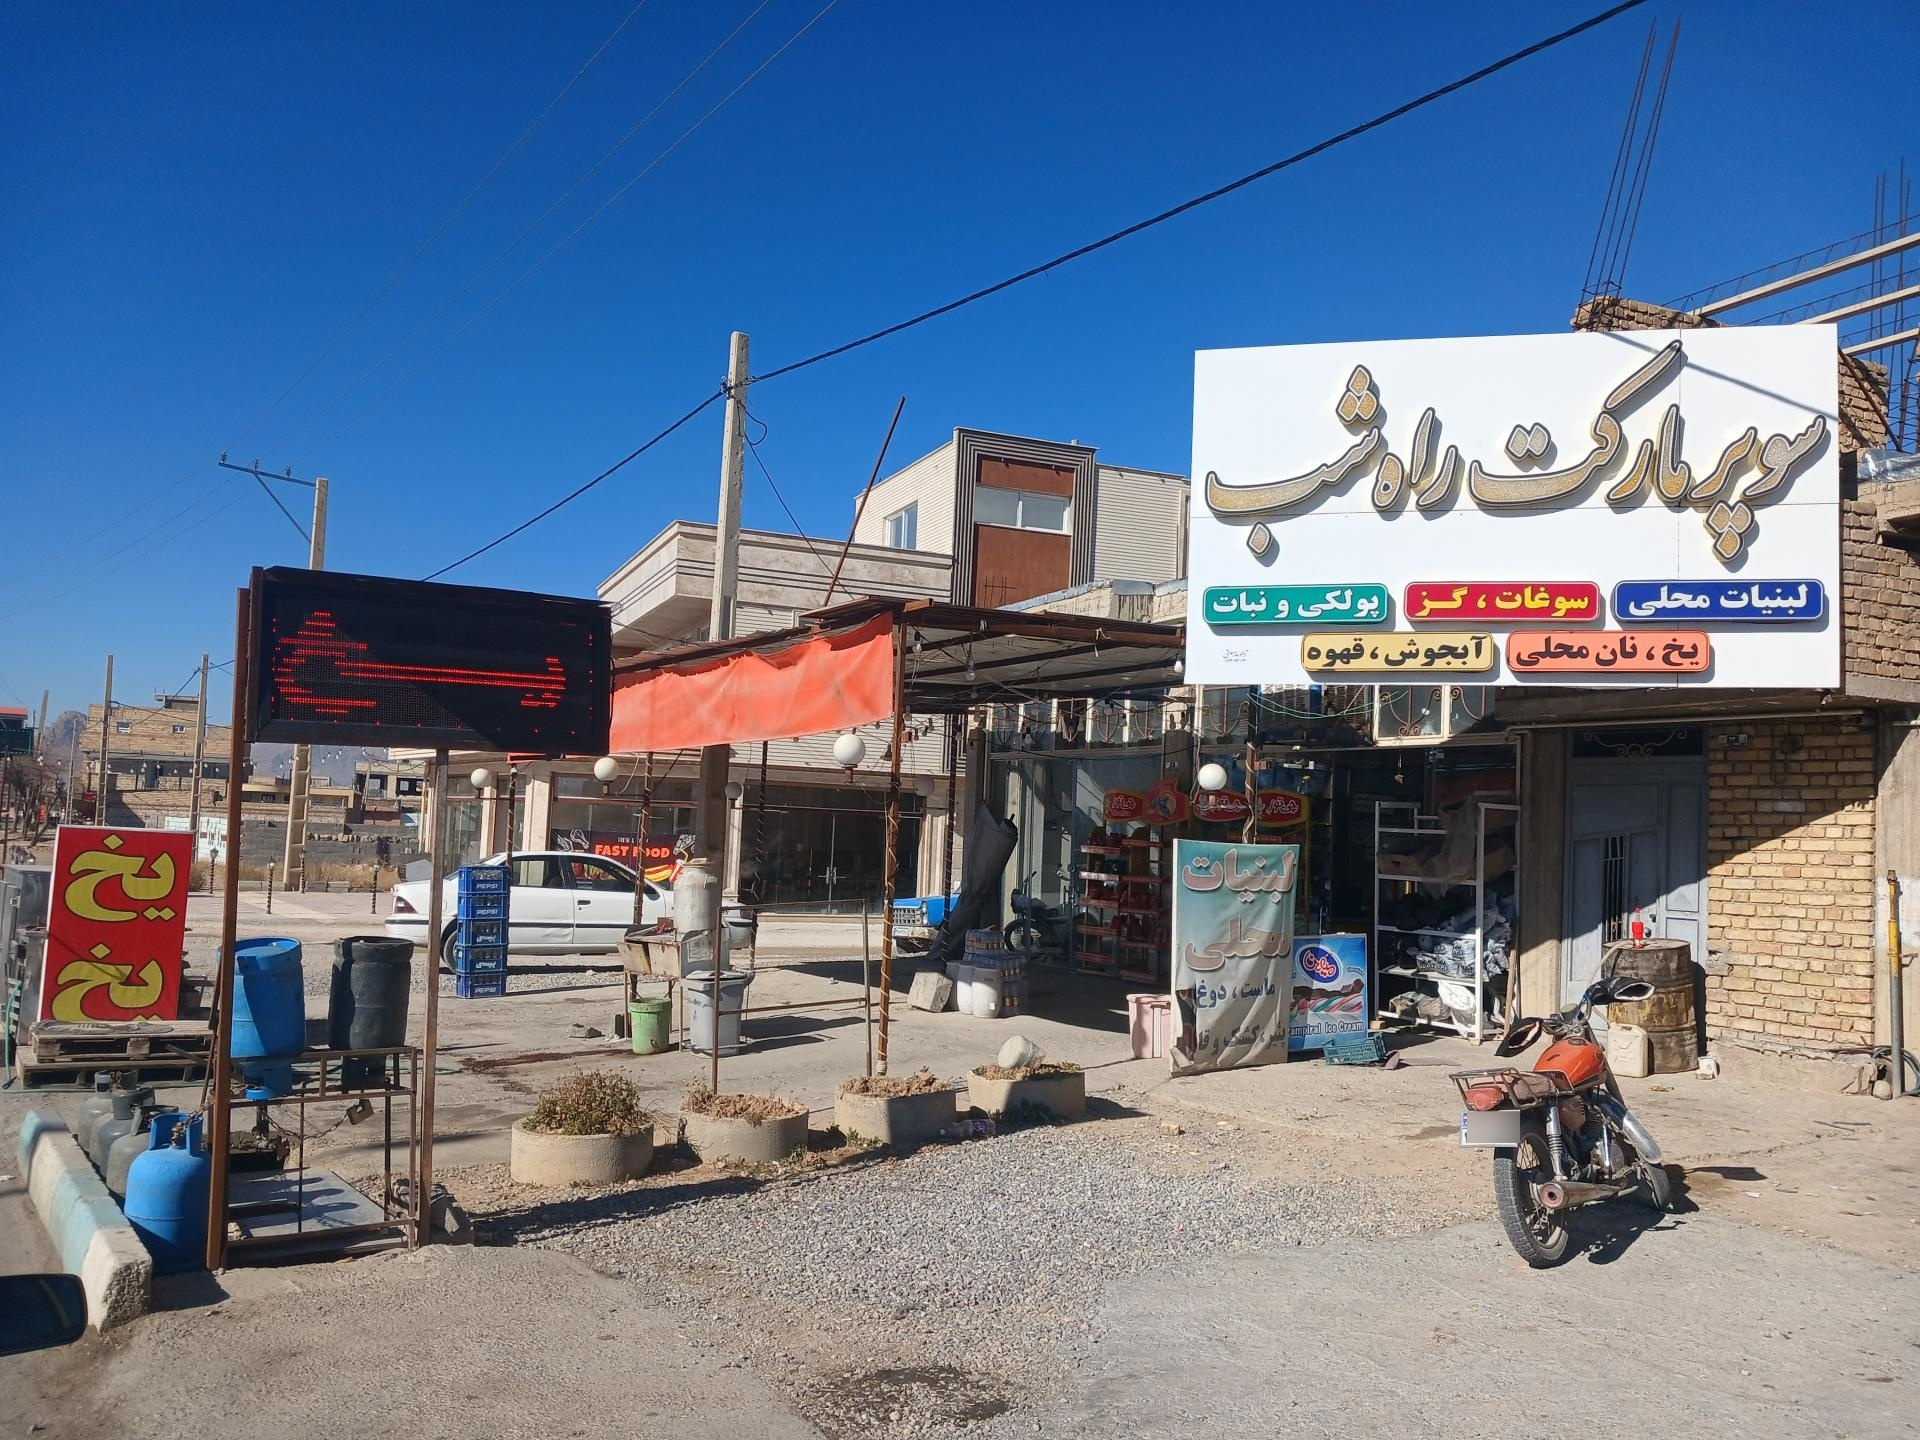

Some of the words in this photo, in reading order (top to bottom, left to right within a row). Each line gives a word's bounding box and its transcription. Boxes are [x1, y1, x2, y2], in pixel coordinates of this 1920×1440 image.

[1469, 339, 1691, 506] مارکت
[1204, 364, 1381, 557] شب
[1371, 407, 1459, 509] راه
[1688, 415, 1826, 561] سوپر
[1212, 589, 1268, 618] نبات
[1274, 602, 1290, 619] و
[1298, 589, 1380, 618] پولکی
[1415, 586, 1469, 618] گز
[1628, 585, 1711, 617] محلی
[1719, 583, 1809, 615] لبنیات
[1306, 637, 1364, 667] قهوه
[1516, 635, 1590, 667] محلی
[1595, 635, 1638, 667] نان
[594, 844, 630, 858] FAST
[65, 834, 176, 922] یخ
[1181, 848, 1296, 904] لبنیات
[1184, 915, 1291, 971] محلی
[475, 986, 497, 994] PEPSI
[1196, 979, 1228, 1009] دوغ
[1325, 1021, 1338, 1034] Ice
[1338, 1020, 1364, 1033] Cream
[1210, 1038, 1219, 1055] و
